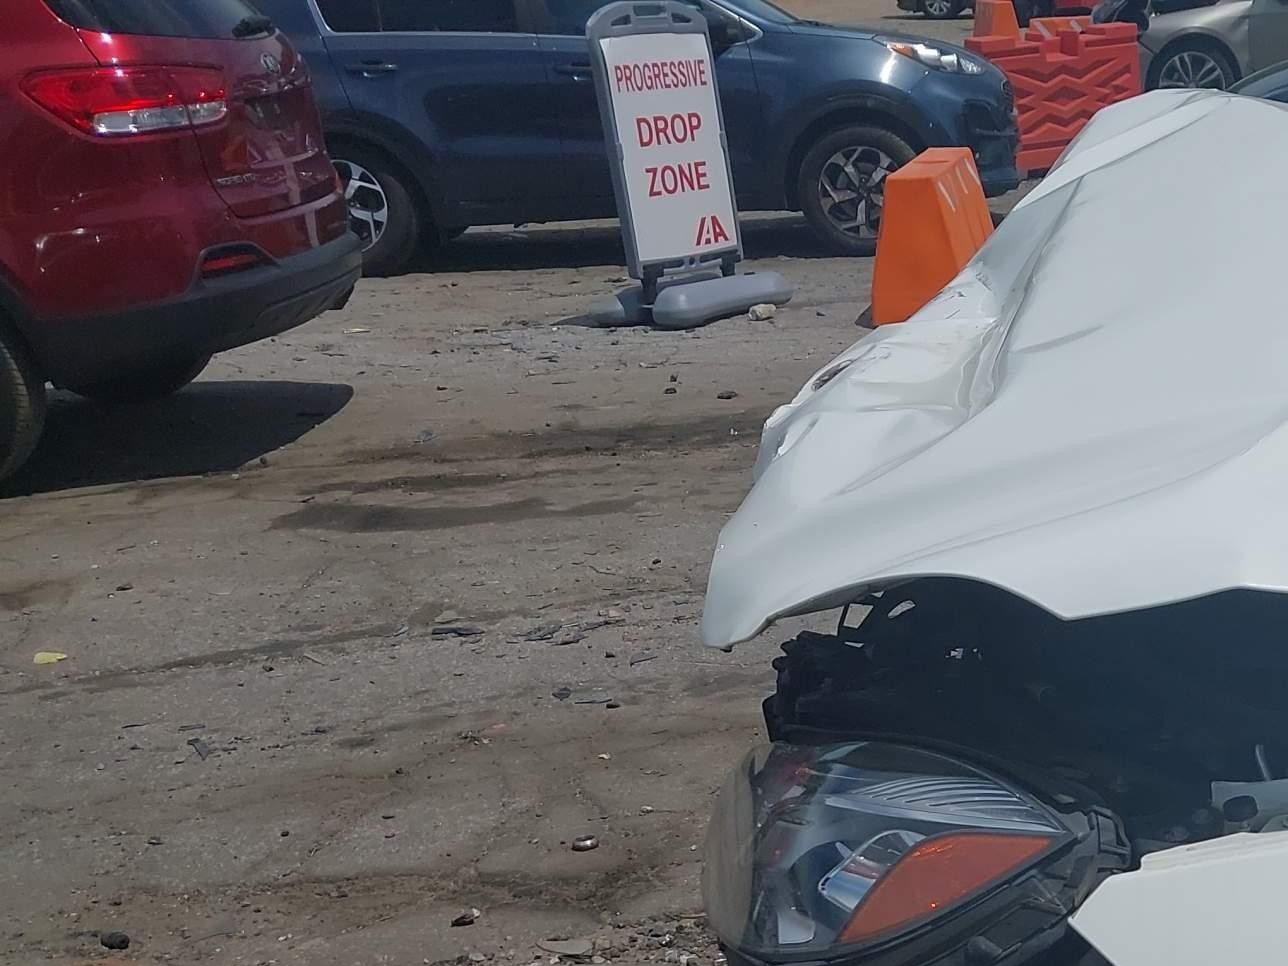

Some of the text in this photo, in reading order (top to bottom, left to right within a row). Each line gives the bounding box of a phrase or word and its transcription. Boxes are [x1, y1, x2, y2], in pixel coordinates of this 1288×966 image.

[614, 59, 707, 93] PROGRESSIVE
[635, 112, 702, 147] DROP
[645, 161, 710, 197] ZONE
